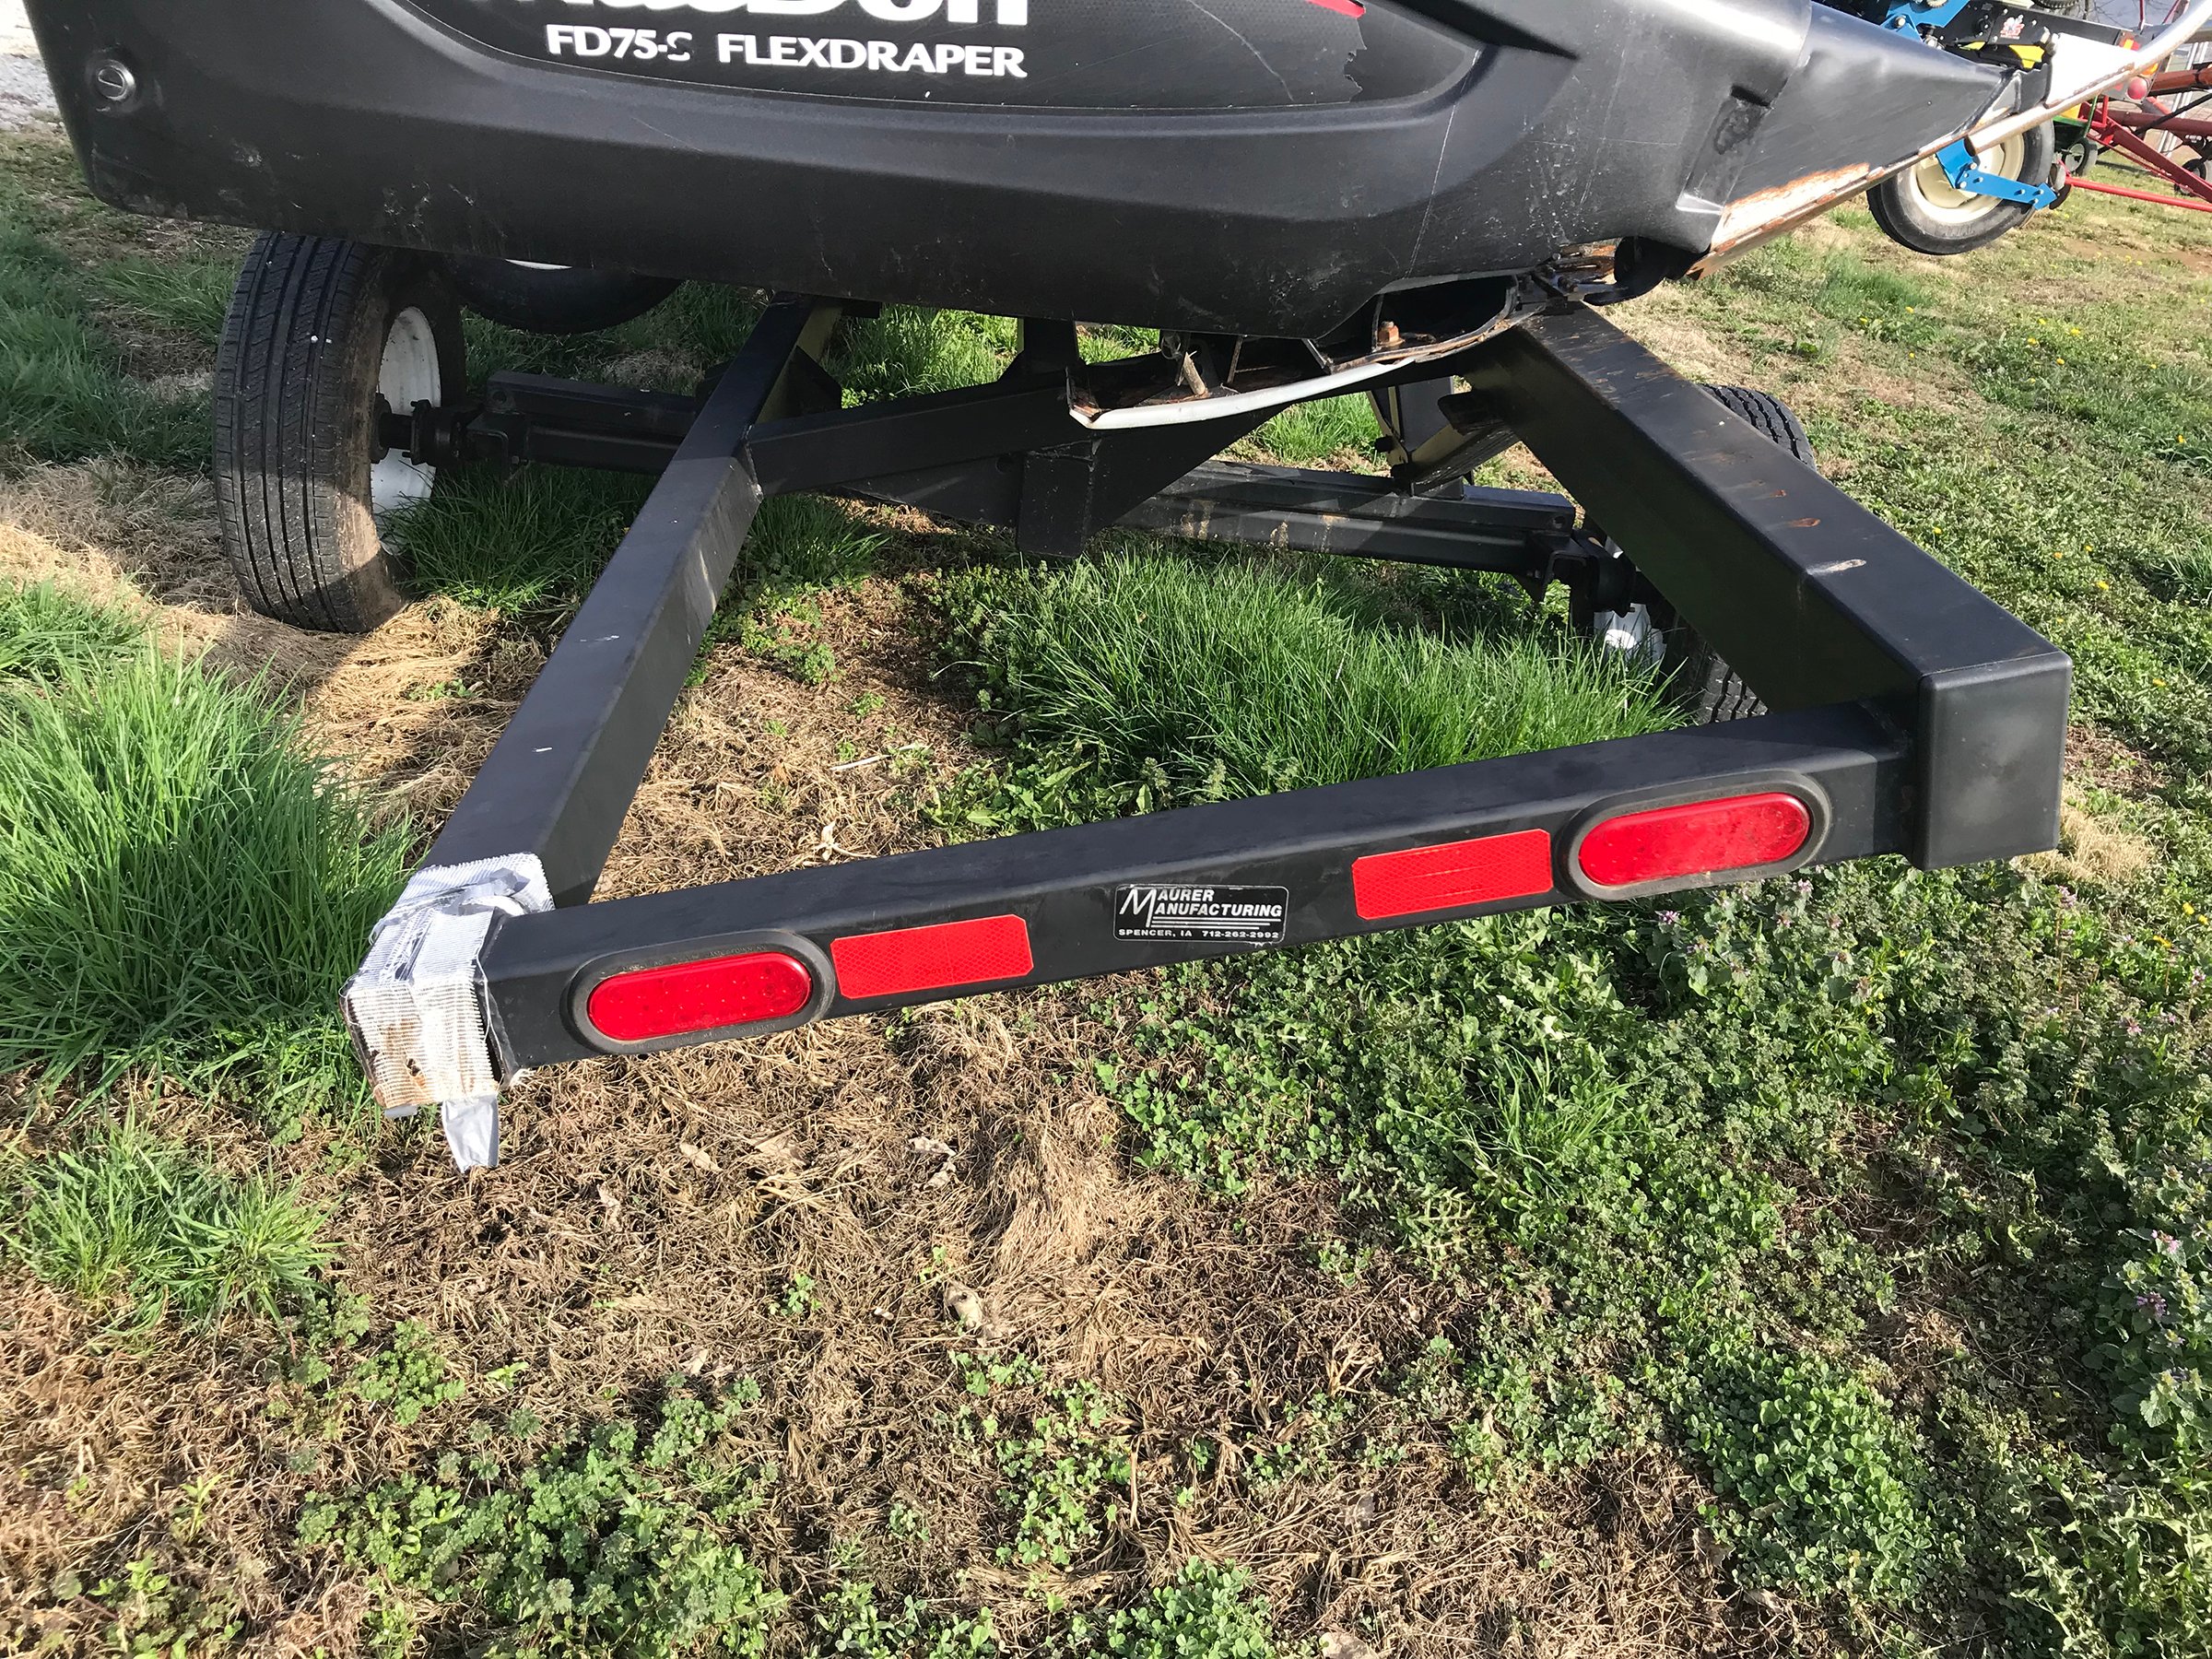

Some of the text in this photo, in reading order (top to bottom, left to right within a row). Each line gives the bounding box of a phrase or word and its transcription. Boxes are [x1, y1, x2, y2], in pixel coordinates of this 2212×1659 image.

[546, 24, 1028, 77] FD75-S FLEXDRAPER
[1118, 929, 1176, 937] SPENCER,
[1202, 930, 1279, 938] 712-262-2992
